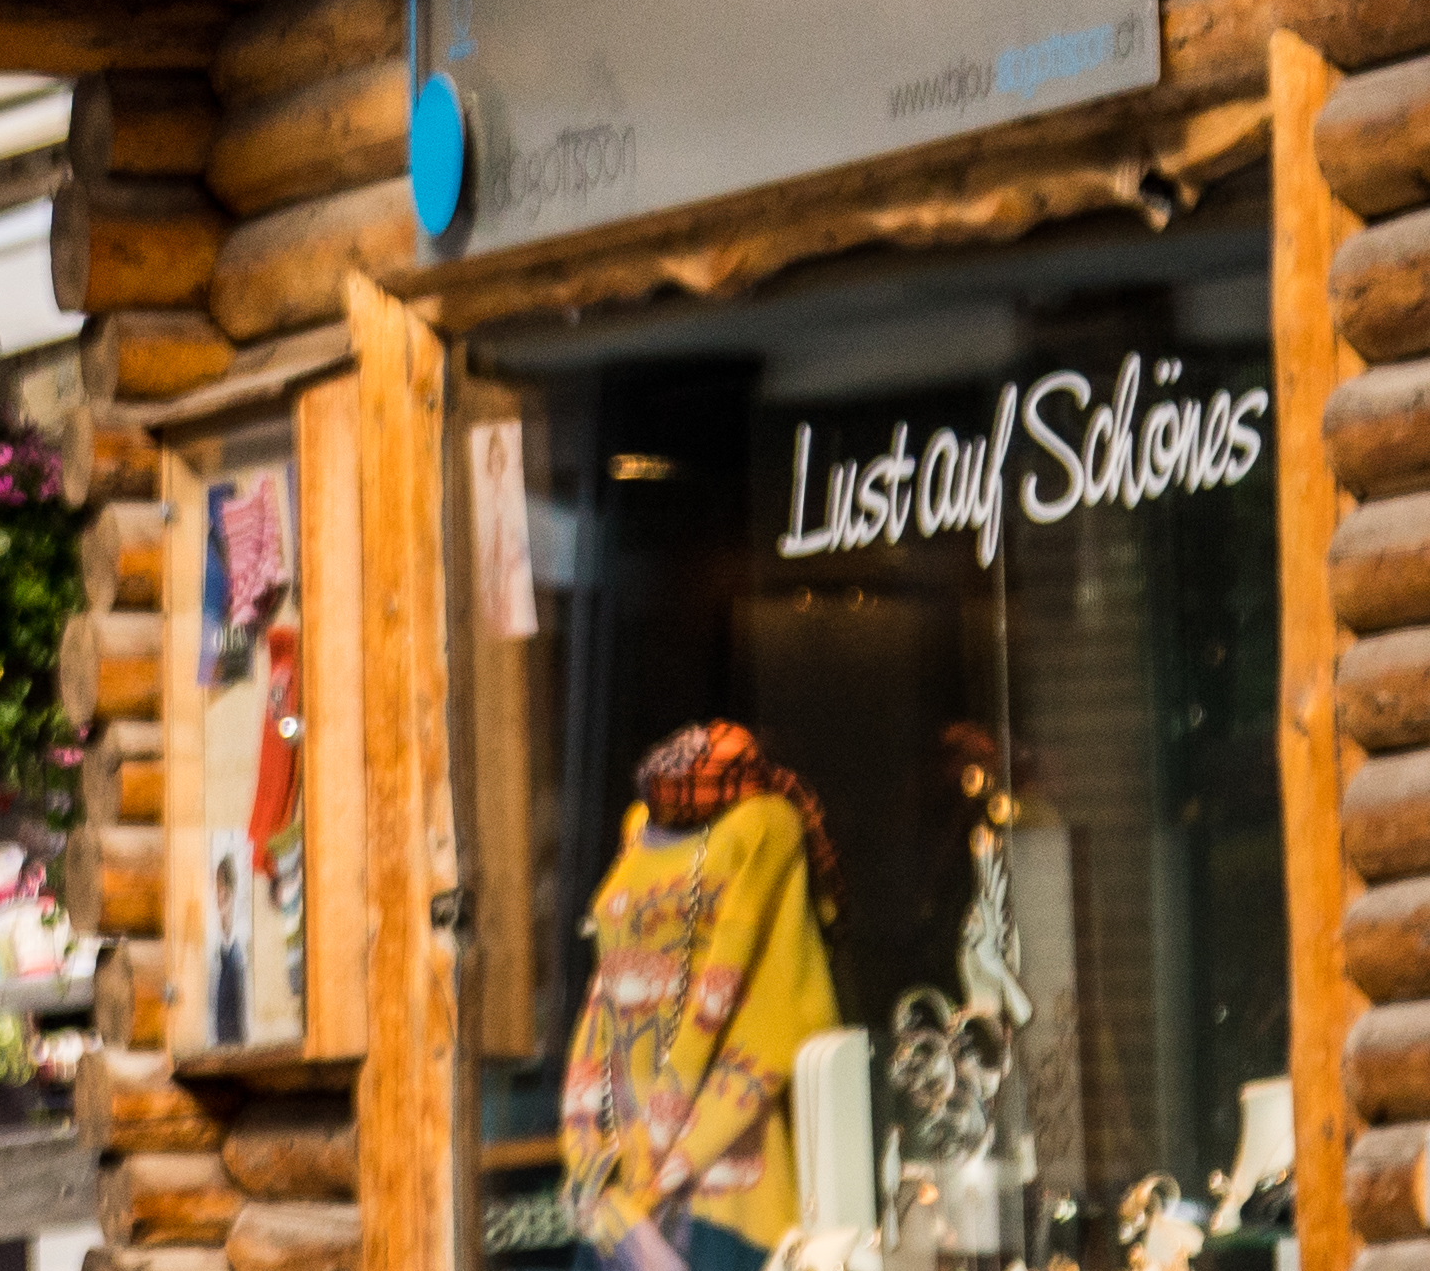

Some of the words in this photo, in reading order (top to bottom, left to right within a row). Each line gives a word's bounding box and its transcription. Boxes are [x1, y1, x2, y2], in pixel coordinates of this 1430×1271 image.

[777, 421, 915, 560] Lust
[915, 381, 1018, 570] auf
[1019, 349, 1270, 525] Schönes
